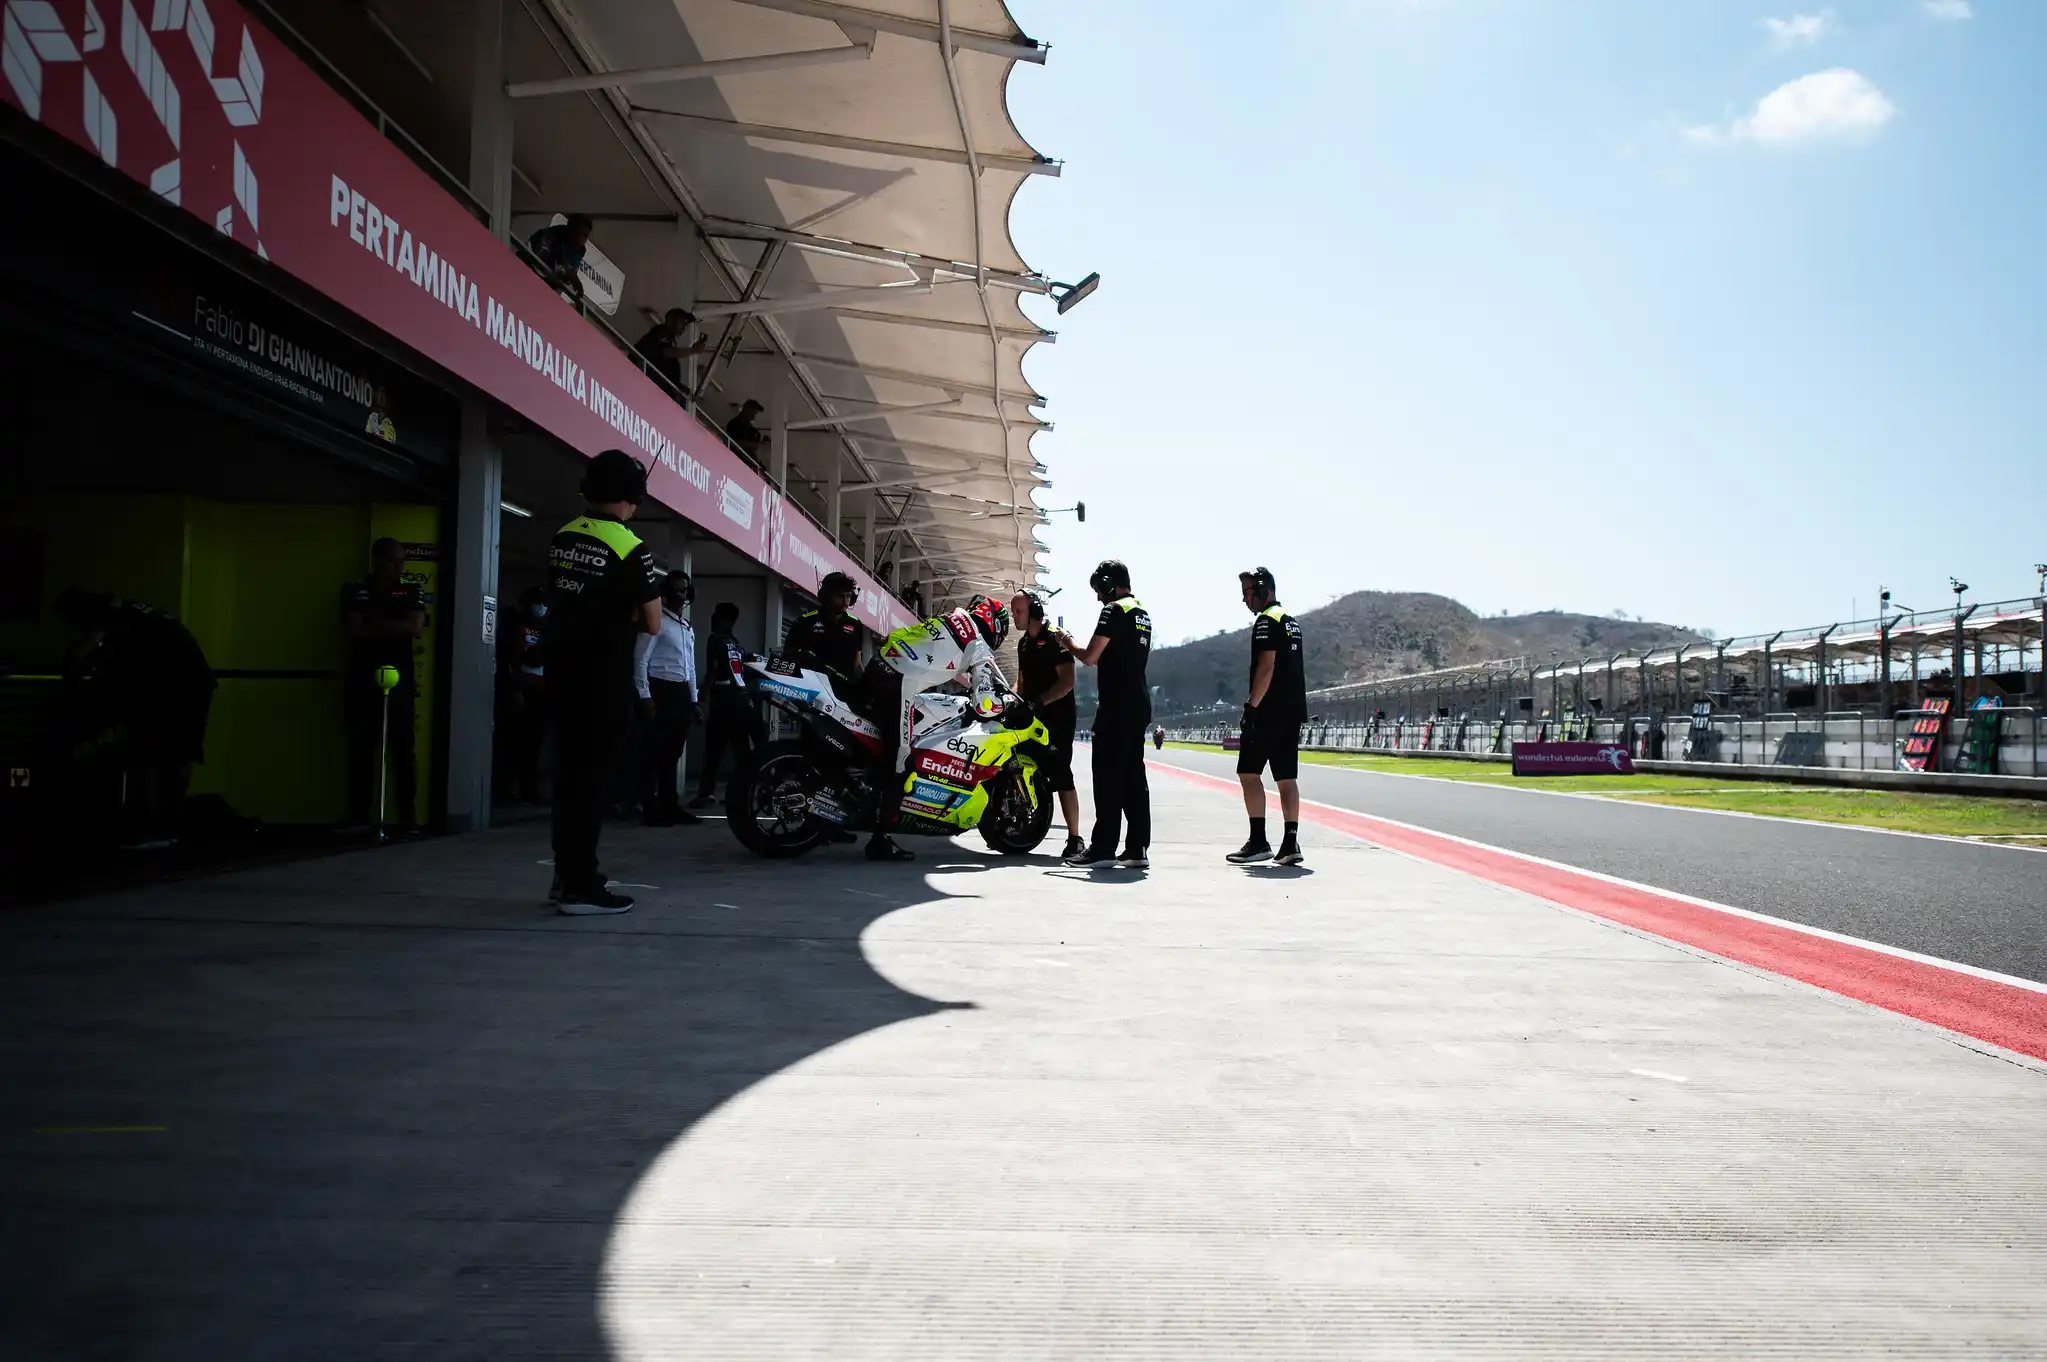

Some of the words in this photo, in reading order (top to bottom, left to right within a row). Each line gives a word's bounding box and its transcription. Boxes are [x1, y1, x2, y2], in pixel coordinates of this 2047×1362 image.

[579, 259, 614, 299] ERTAMINA
[330, 172, 481, 330] PERTAMINA
[485, 296, 587, 406] MANDALIKA
[590, 377, 677, 473] INTERNATIONAL
[678, 449, 711, 494] CIRCUIT
[194, 295, 243, 346] Fabio
[247, 320, 266, 357] DI
[268, 333, 374, 408] GIANNANTONIO
[575, 542, 608, 556] PERTAMINA
[555, 575, 585, 595] ebay
[760, 682, 783, 694] COMOLI
[825, 734, 845, 751] IVECO
[947, 736, 986, 762] ebay
[1517, 753, 1563, 762] wonderful
[922, 757, 973, 782] Enduro
[928, 774, 950, 785] VR46
[915, 785, 940, 800] COMOLI
